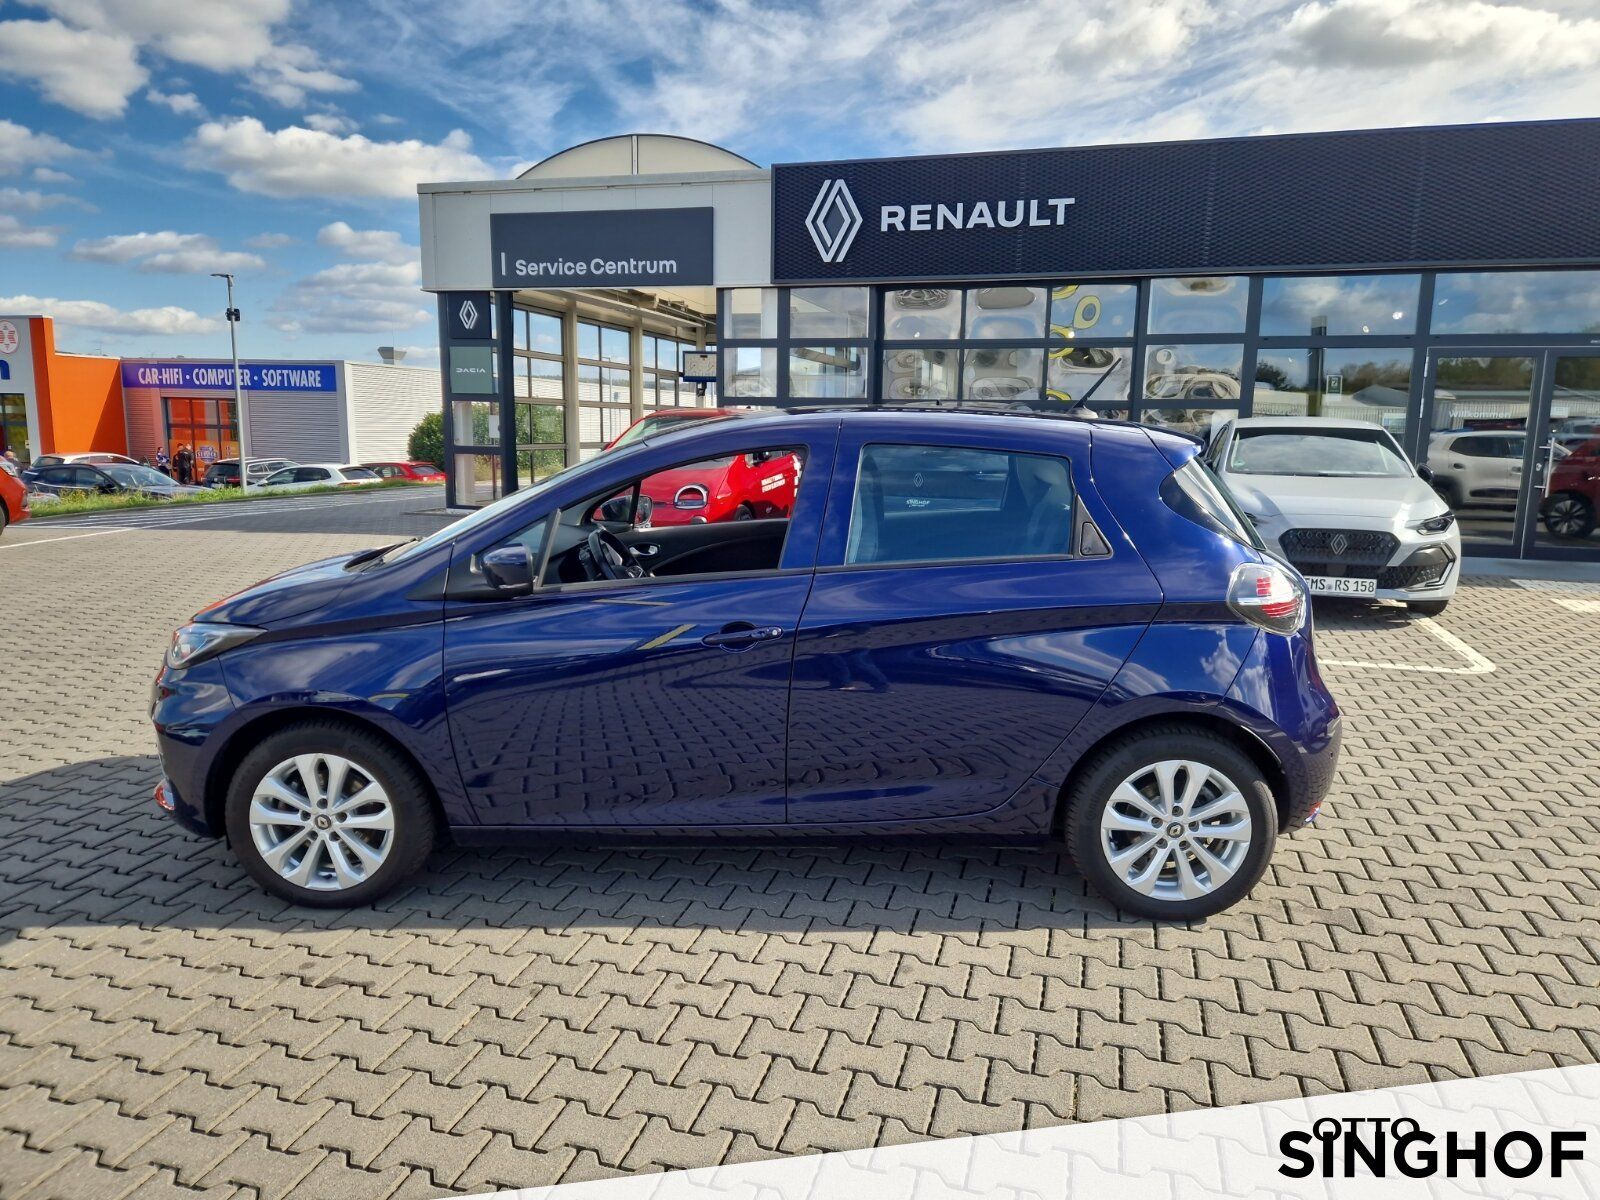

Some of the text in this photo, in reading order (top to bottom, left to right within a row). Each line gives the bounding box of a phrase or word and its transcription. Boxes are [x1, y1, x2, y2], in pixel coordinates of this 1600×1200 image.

[880, 197, 1076, 232] RENAULT
[515, 257, 677, 276] Service Centrum
[138, 367, 183, 385] CAR-HIFI
[261, 369, 322, 388] SOFTWARE
[1334, 580, 1350, 592] RS
[1352, 581, 1375, 593] 158
